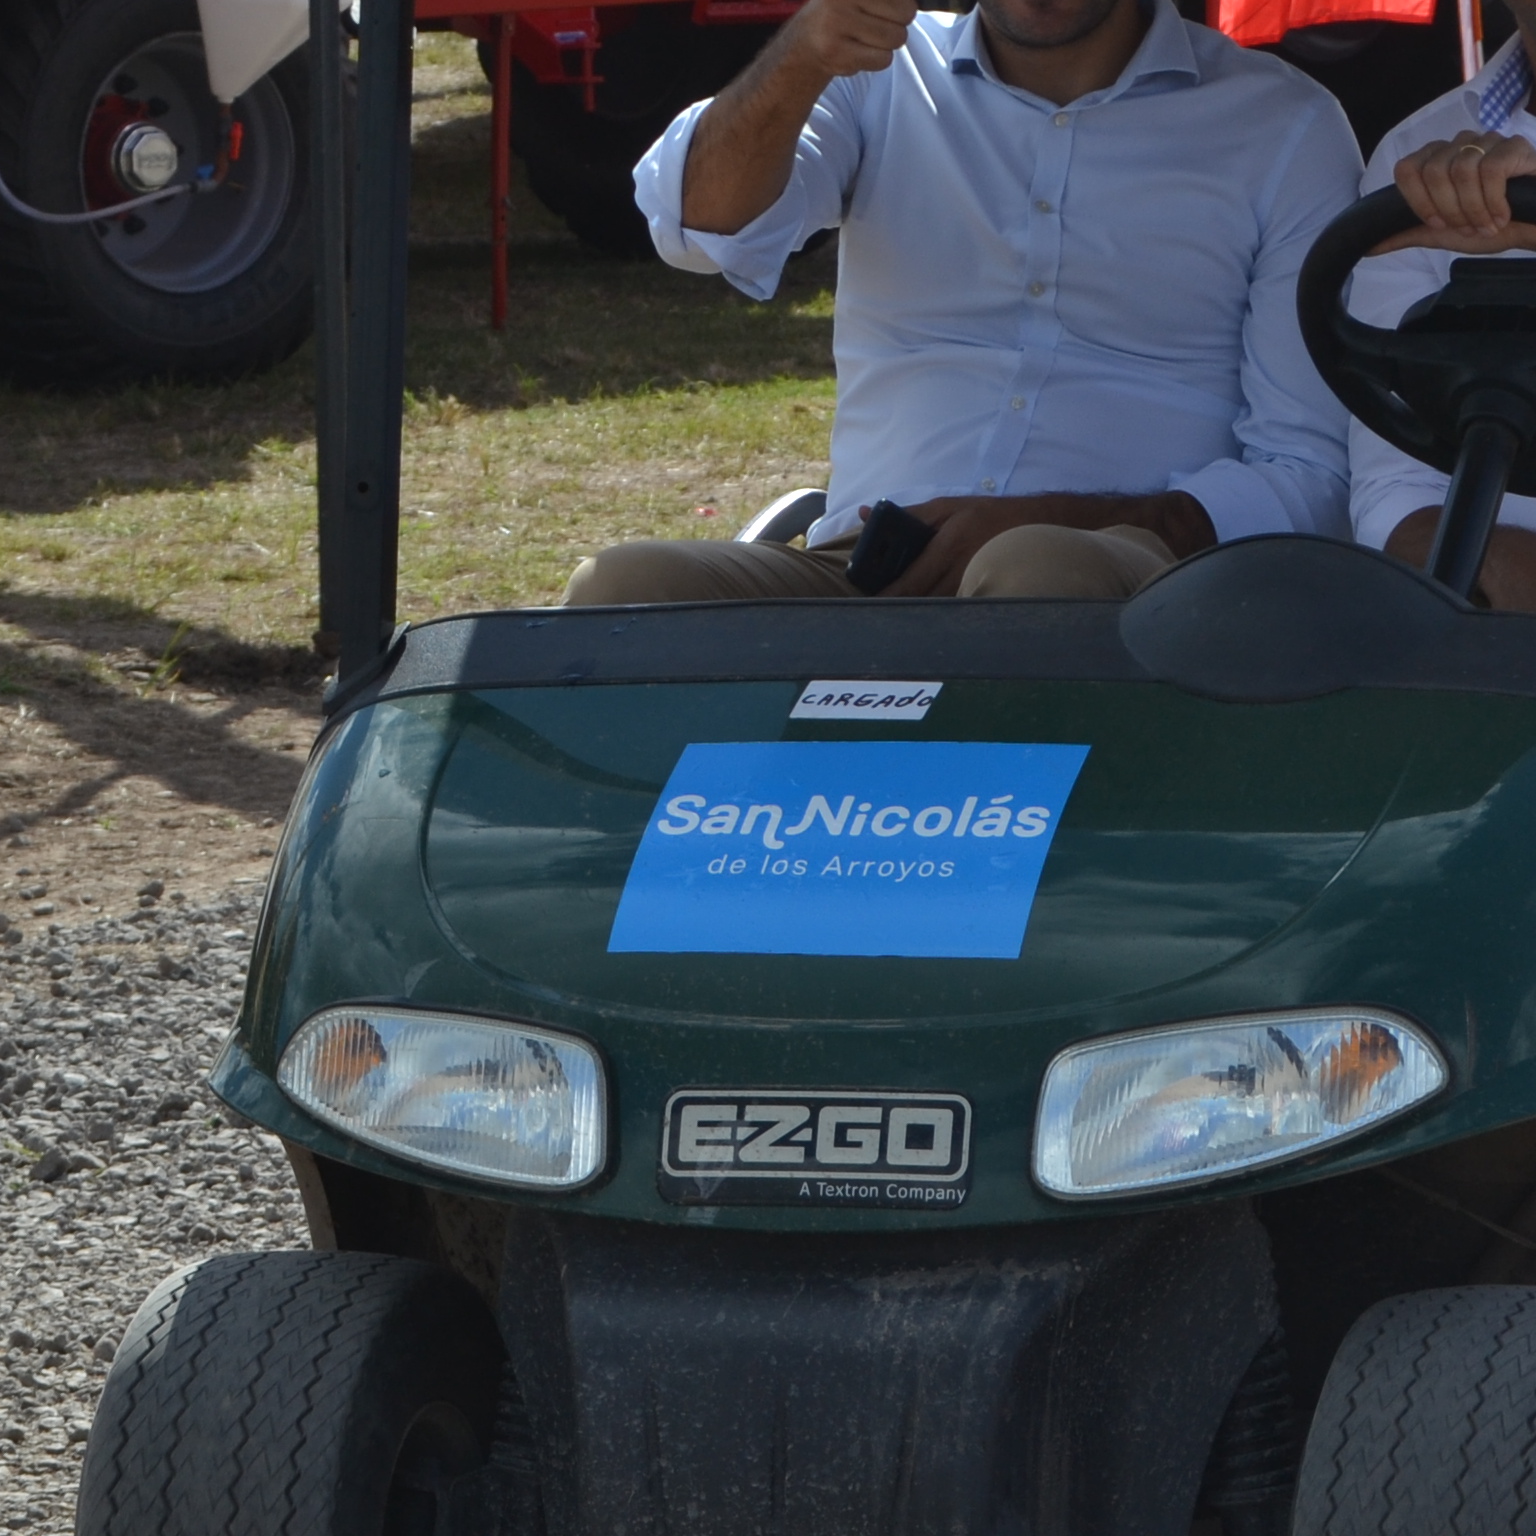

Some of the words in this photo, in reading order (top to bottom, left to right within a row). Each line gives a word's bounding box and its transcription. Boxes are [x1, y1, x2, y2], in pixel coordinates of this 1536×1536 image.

[657, 794, 785, 850] San
[785, 794, 1051, 839] Nicolás
[708, 854, 746, 875] de
[760, 854, 808, 876] los
[821, 856, 956, 882] Arroyos
[799, 1182, 811, 1196] A
[817, 1182, 879, 1198] Textron
[886, 1184, 966, 1203] Company
